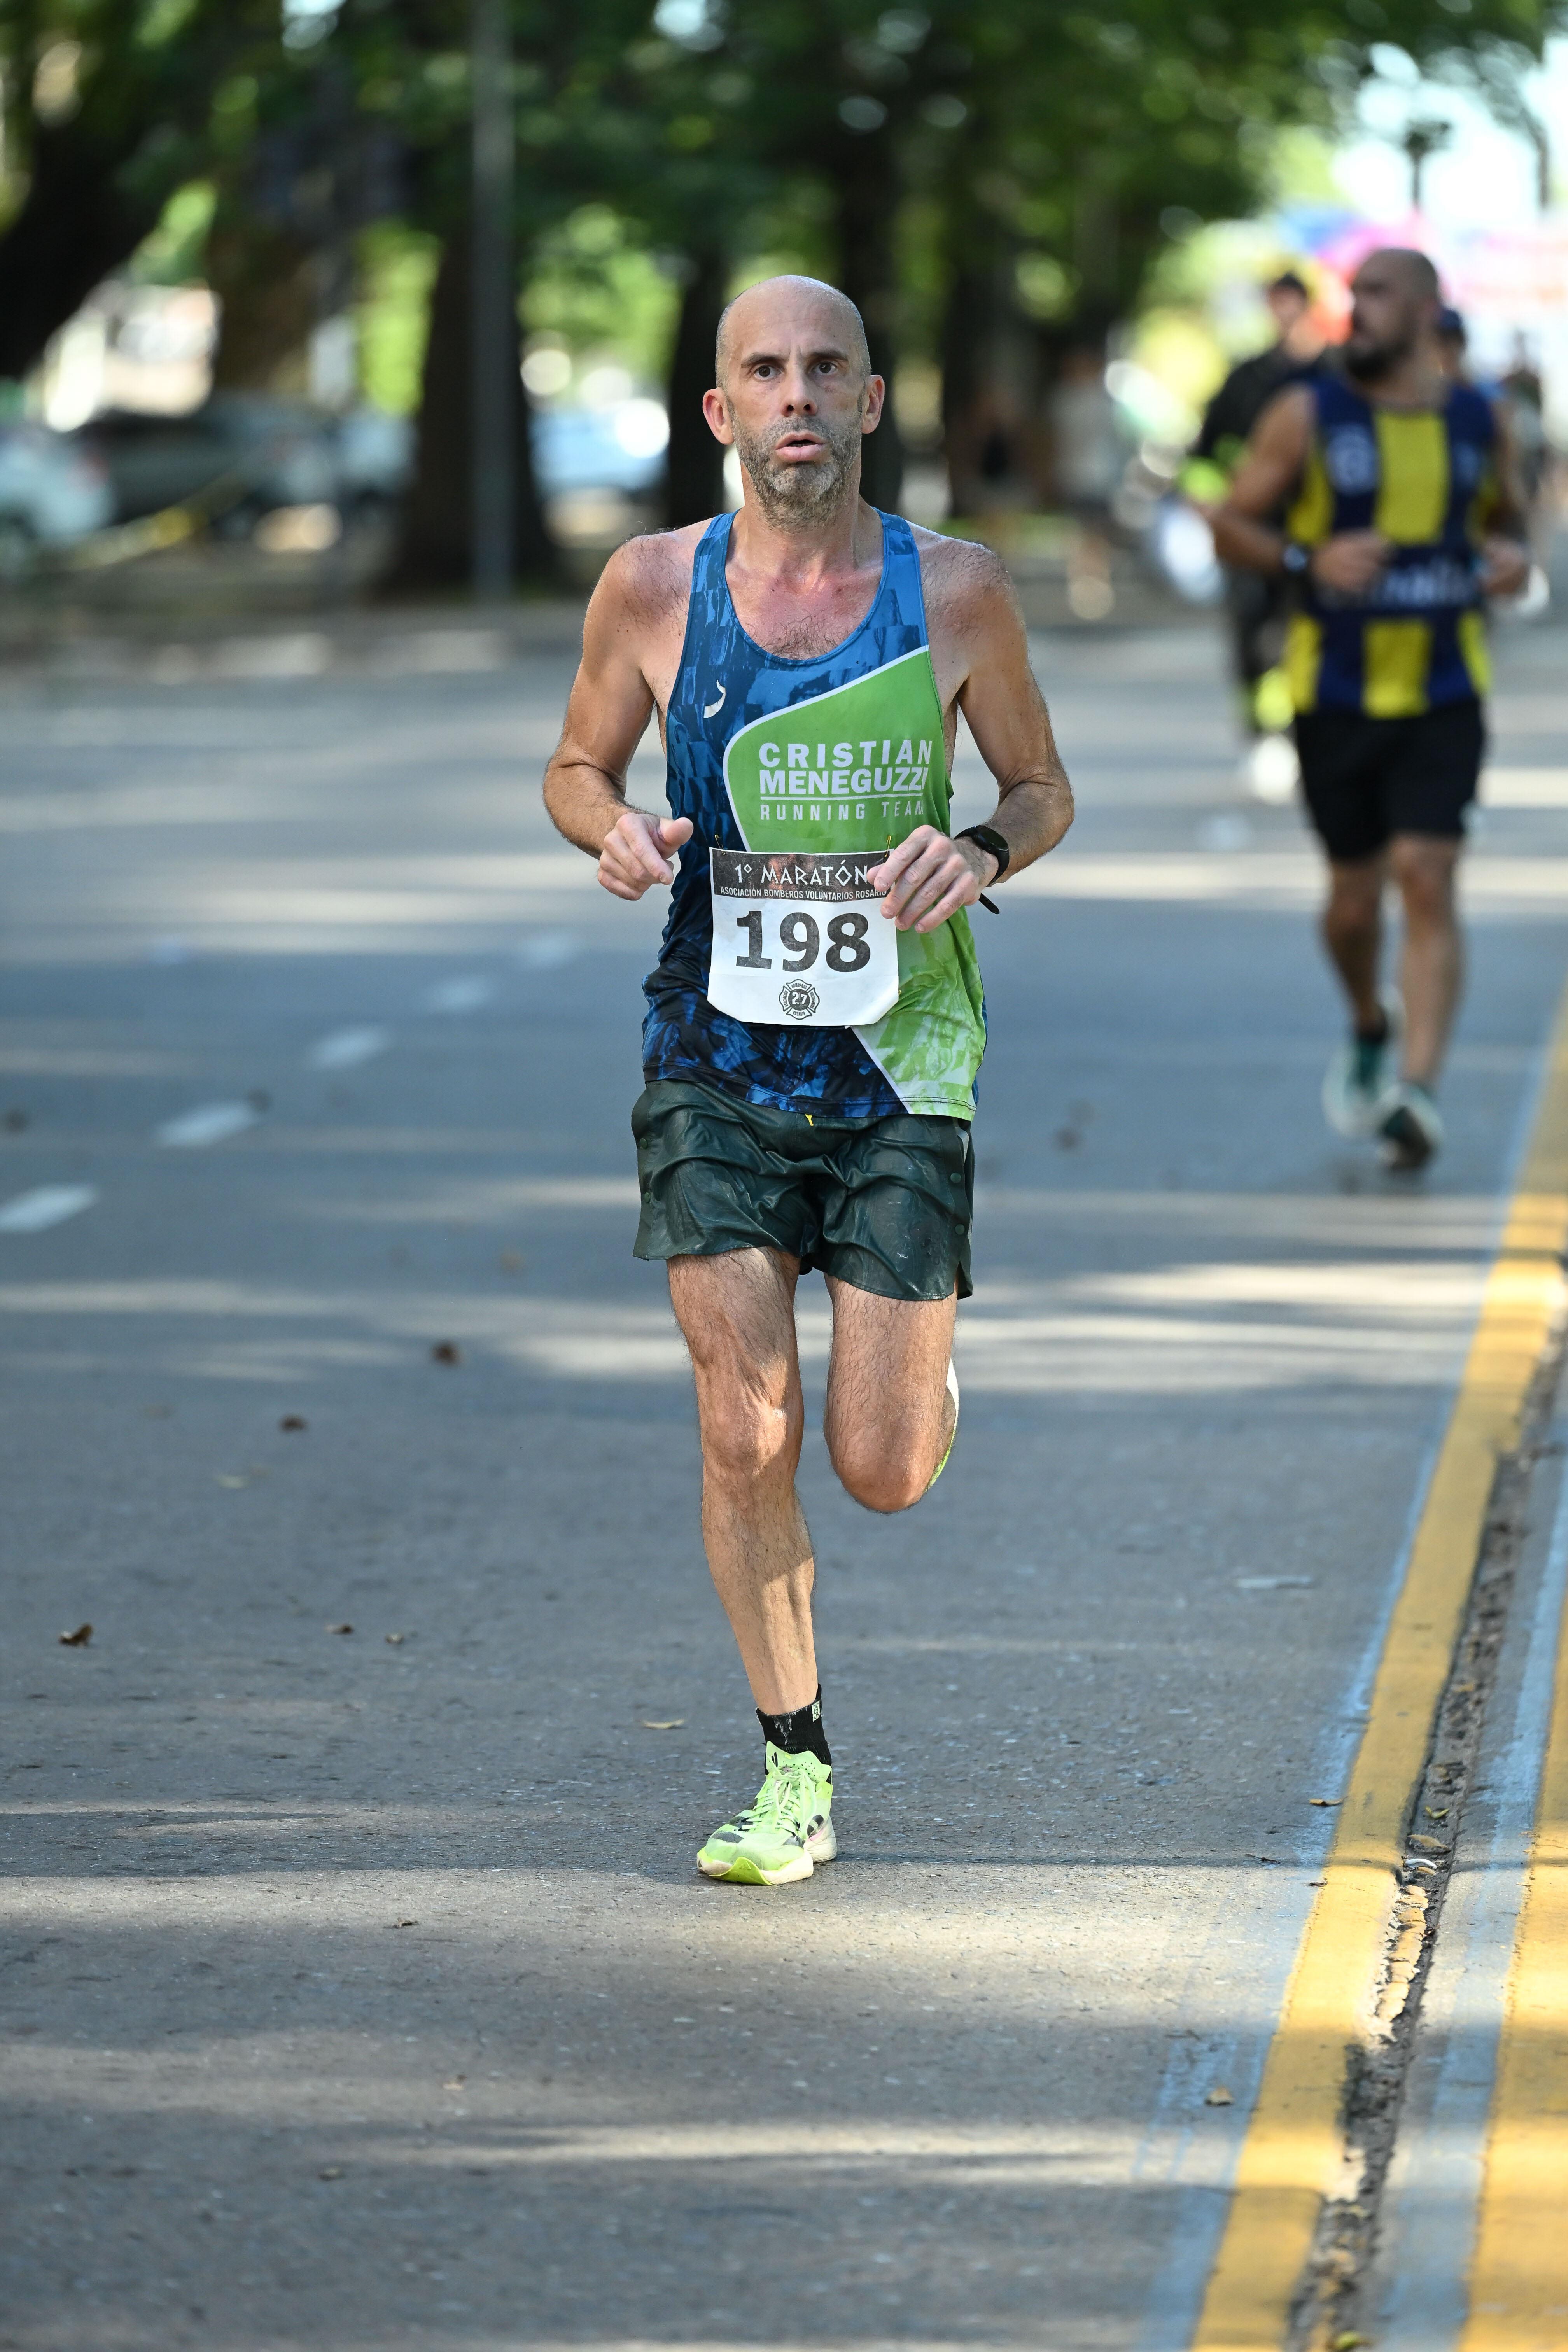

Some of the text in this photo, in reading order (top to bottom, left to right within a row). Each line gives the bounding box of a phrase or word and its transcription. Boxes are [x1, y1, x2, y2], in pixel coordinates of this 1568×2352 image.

[759, 740, 932, 768] CRISTIAN
[760, 767, 929, 794] MENEGUZZI
[760, 800, 923, 821] RUNNING TEAM
[761, 859, 868, 886] MARATÓN
[721, 886, 762, 897] ASOCIACIÓN
[764, 889, 803, 899] BOMBEROS
[805, 891, 853, 901] VOLUNTARIOS
[736, 910, 871, 973] 198
[792, 991, 807, 1005] 27
